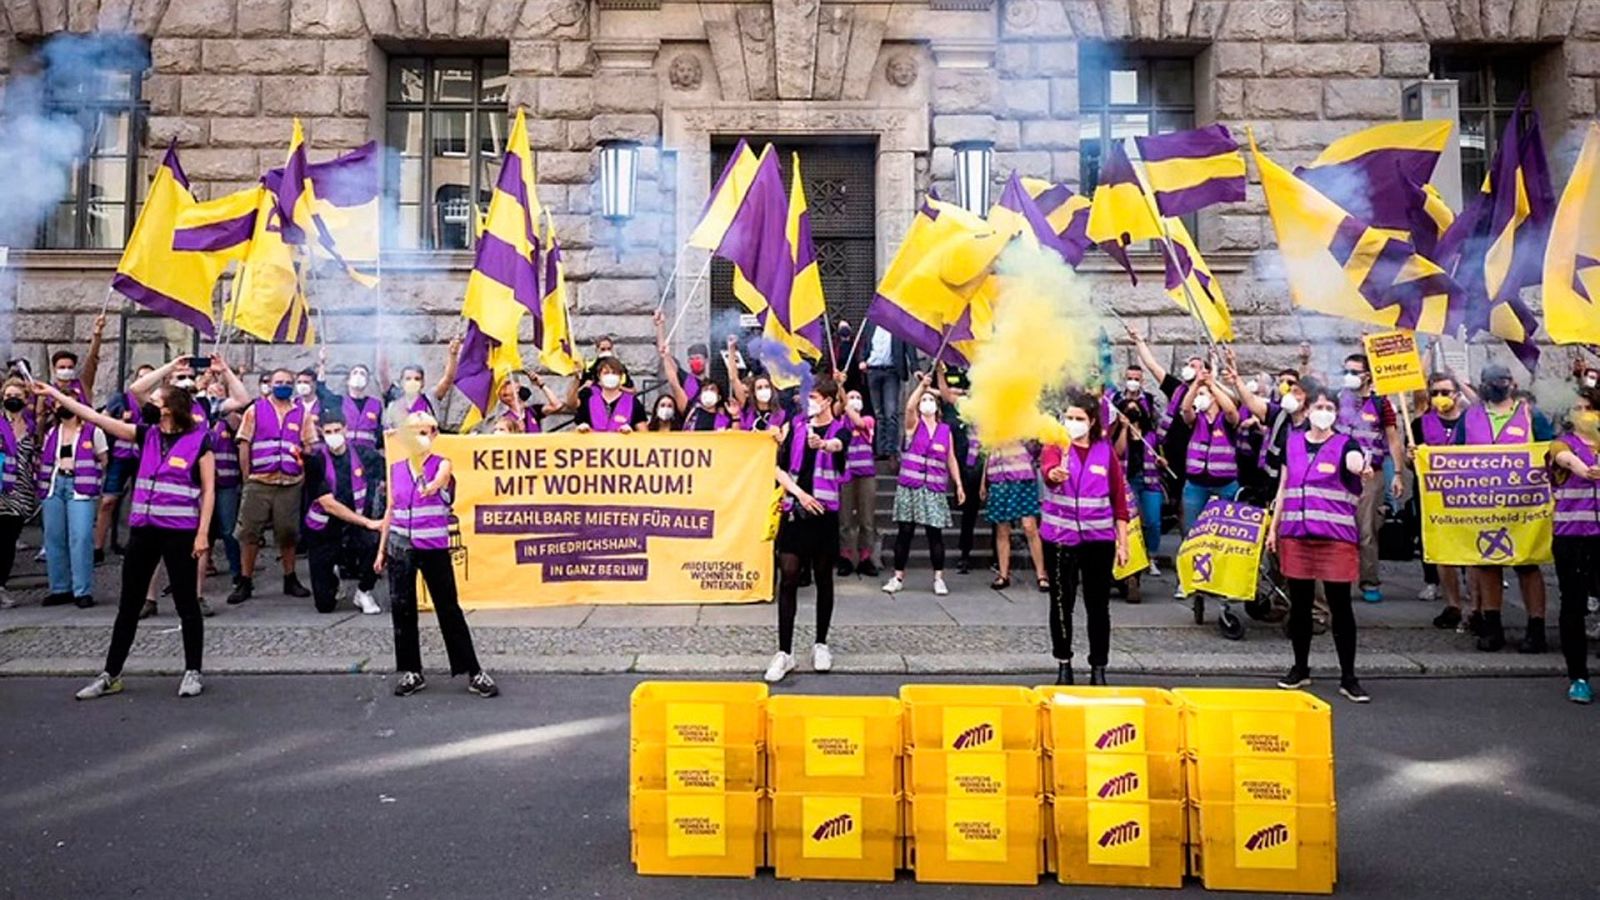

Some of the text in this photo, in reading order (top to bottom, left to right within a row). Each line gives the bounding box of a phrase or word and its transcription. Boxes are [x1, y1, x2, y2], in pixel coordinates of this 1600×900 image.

[473, 448, 712, 471] KEINE SPEKULATION
[1431, 455, 1525, 469] Deutsche
[495, 474, 692, 497] MIT WOHNRAUM!
[1426, 474, 1502, 489] Wohnen
[1507, 471, 1521, 485] &
[1445, 489, 1545, 508] enteignen
[483, 509, 710, 530] BEZAHLBARE MIETEN FÜR ALLE
[1223, 503, 1236, 517] &
[1239, 506, 1262, 522] Co
[1429, 511, 1520, 525] Volksentscheid
[524, 544, 538, 557] IN
[550, 564, 645, 576] IN GANZ BERLIN!
[695, 561, 743, 571] DEUTSCHE
[691, 571, 733, 580] WOHNEN
[745, 571, 760, 580] CO
[700, 580, 753, 590] ENTEIGNEN
